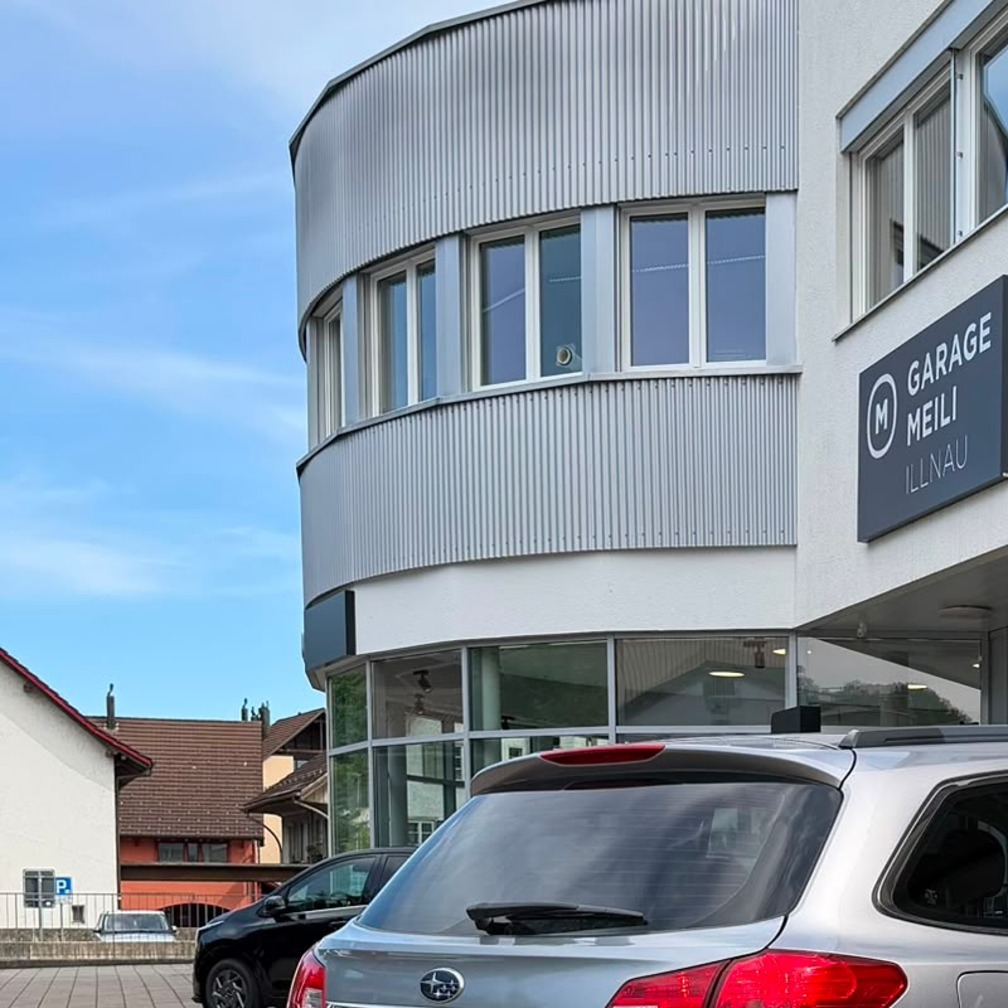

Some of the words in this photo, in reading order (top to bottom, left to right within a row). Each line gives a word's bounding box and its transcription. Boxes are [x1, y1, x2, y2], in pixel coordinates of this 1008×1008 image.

[907, 312, 992, 396] GARAGE
[875, 398, 889, 435] M
[907, 385, 958, 447] MEILI
[906, 434, 969, 495] ILLNAU
[56, 879, 68, 894] P
